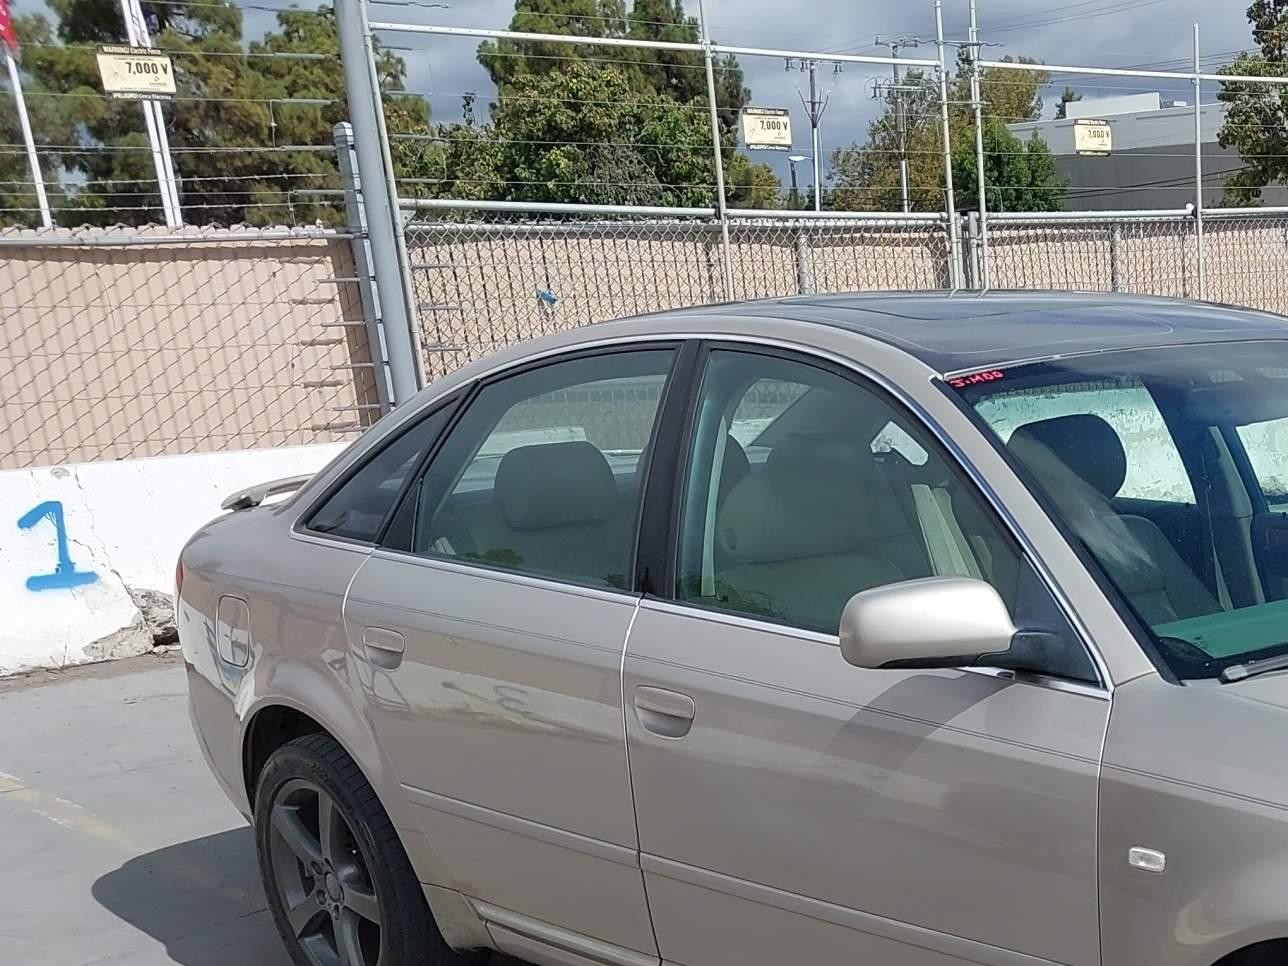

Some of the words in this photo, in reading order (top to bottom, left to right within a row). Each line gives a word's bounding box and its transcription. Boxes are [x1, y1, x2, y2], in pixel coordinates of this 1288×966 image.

[125, 61, 159, 75] 7,000
[160, 63, 168, 75] V
[760, 120, 781, 131] 7,000
[782, 121, 788, 131] V
[17, 500, 100, 593] 1
